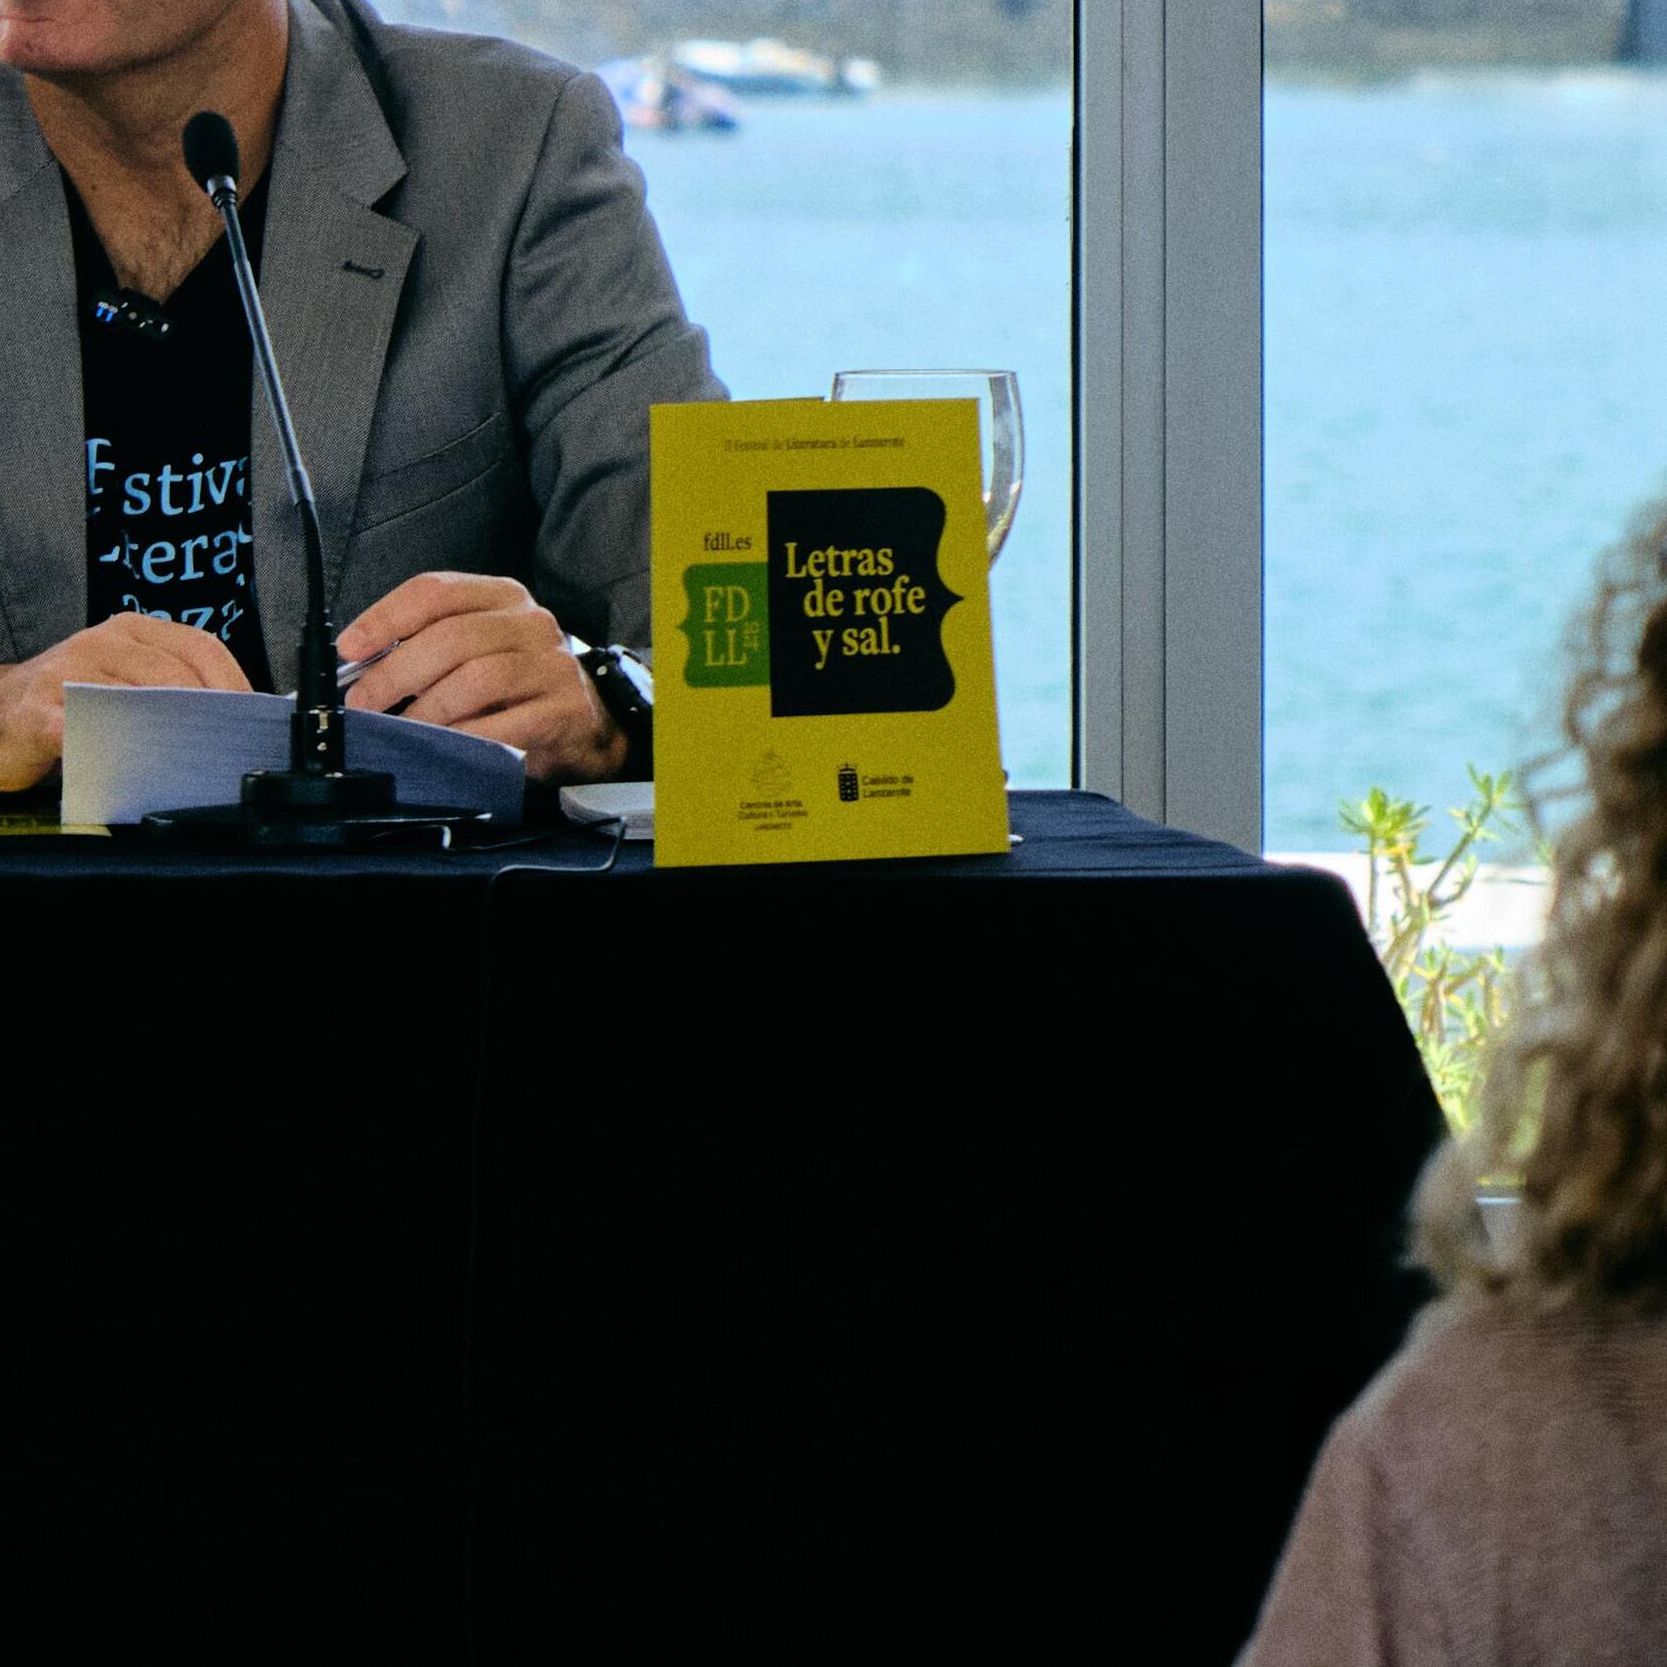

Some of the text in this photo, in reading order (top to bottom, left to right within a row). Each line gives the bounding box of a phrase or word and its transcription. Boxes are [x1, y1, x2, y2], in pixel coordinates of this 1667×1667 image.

[704, 532, 753, 551] fdll.es
[784, 542, 895, 578] Letras
[703, 584, 751, 623] FD
[803, 575, 926, 617] de rofe
[704, 628, 749, 666] LL
[812, 615, 901, 670] y sal.
